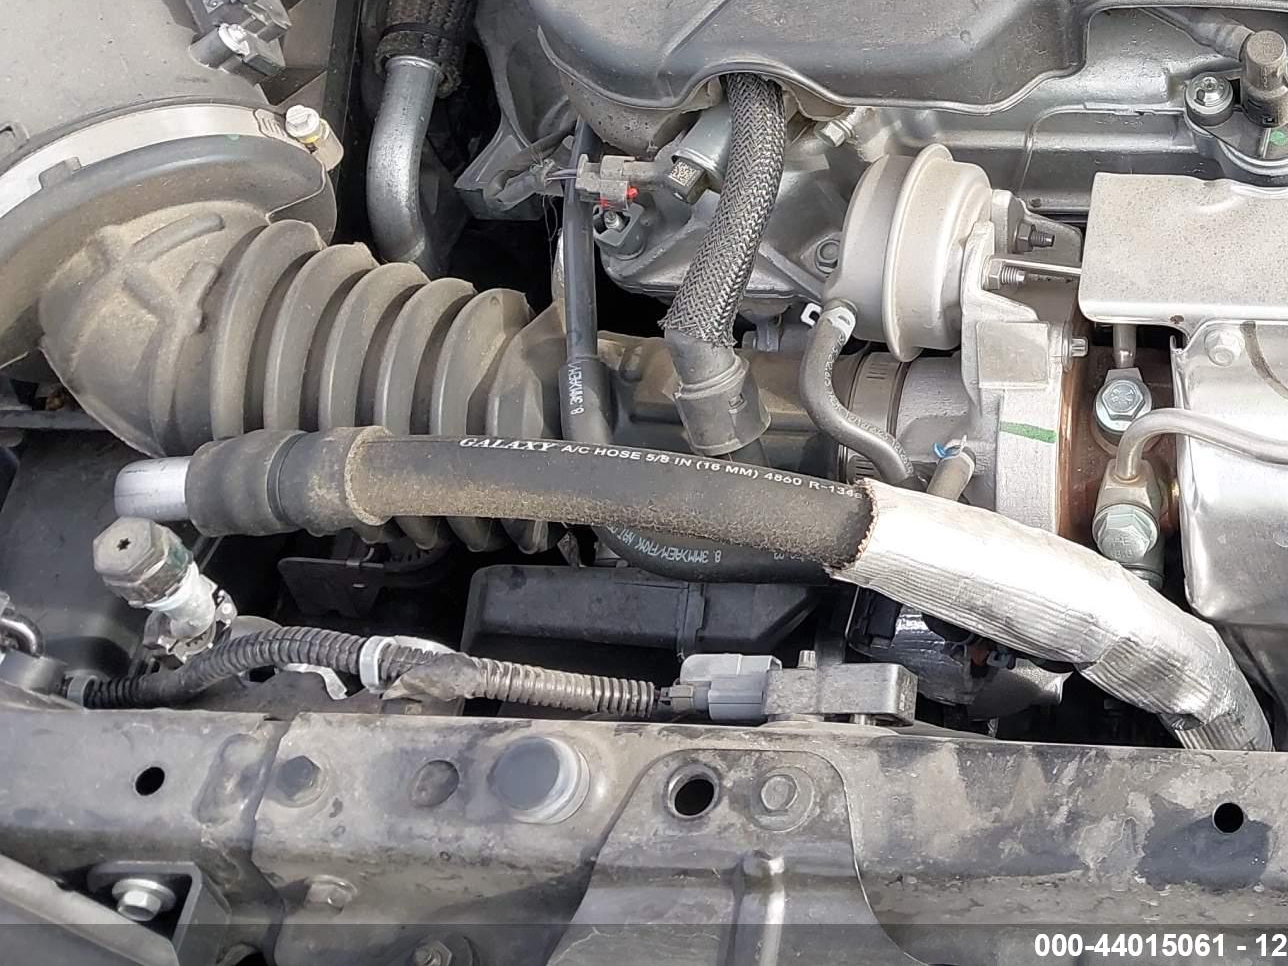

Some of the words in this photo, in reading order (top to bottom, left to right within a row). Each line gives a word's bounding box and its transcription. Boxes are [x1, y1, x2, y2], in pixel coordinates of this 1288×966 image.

[459, 438, 559, 452] GALAXY
[561, 444, 589, 454] A/C
[594, 447, 642, 460] HOSE
[645, 453, 670, 464] 5/8
[674, 457, 691, 467] IN
[725, 465, 759, 480] MM)
[764, 472, 802, 486] 4860
